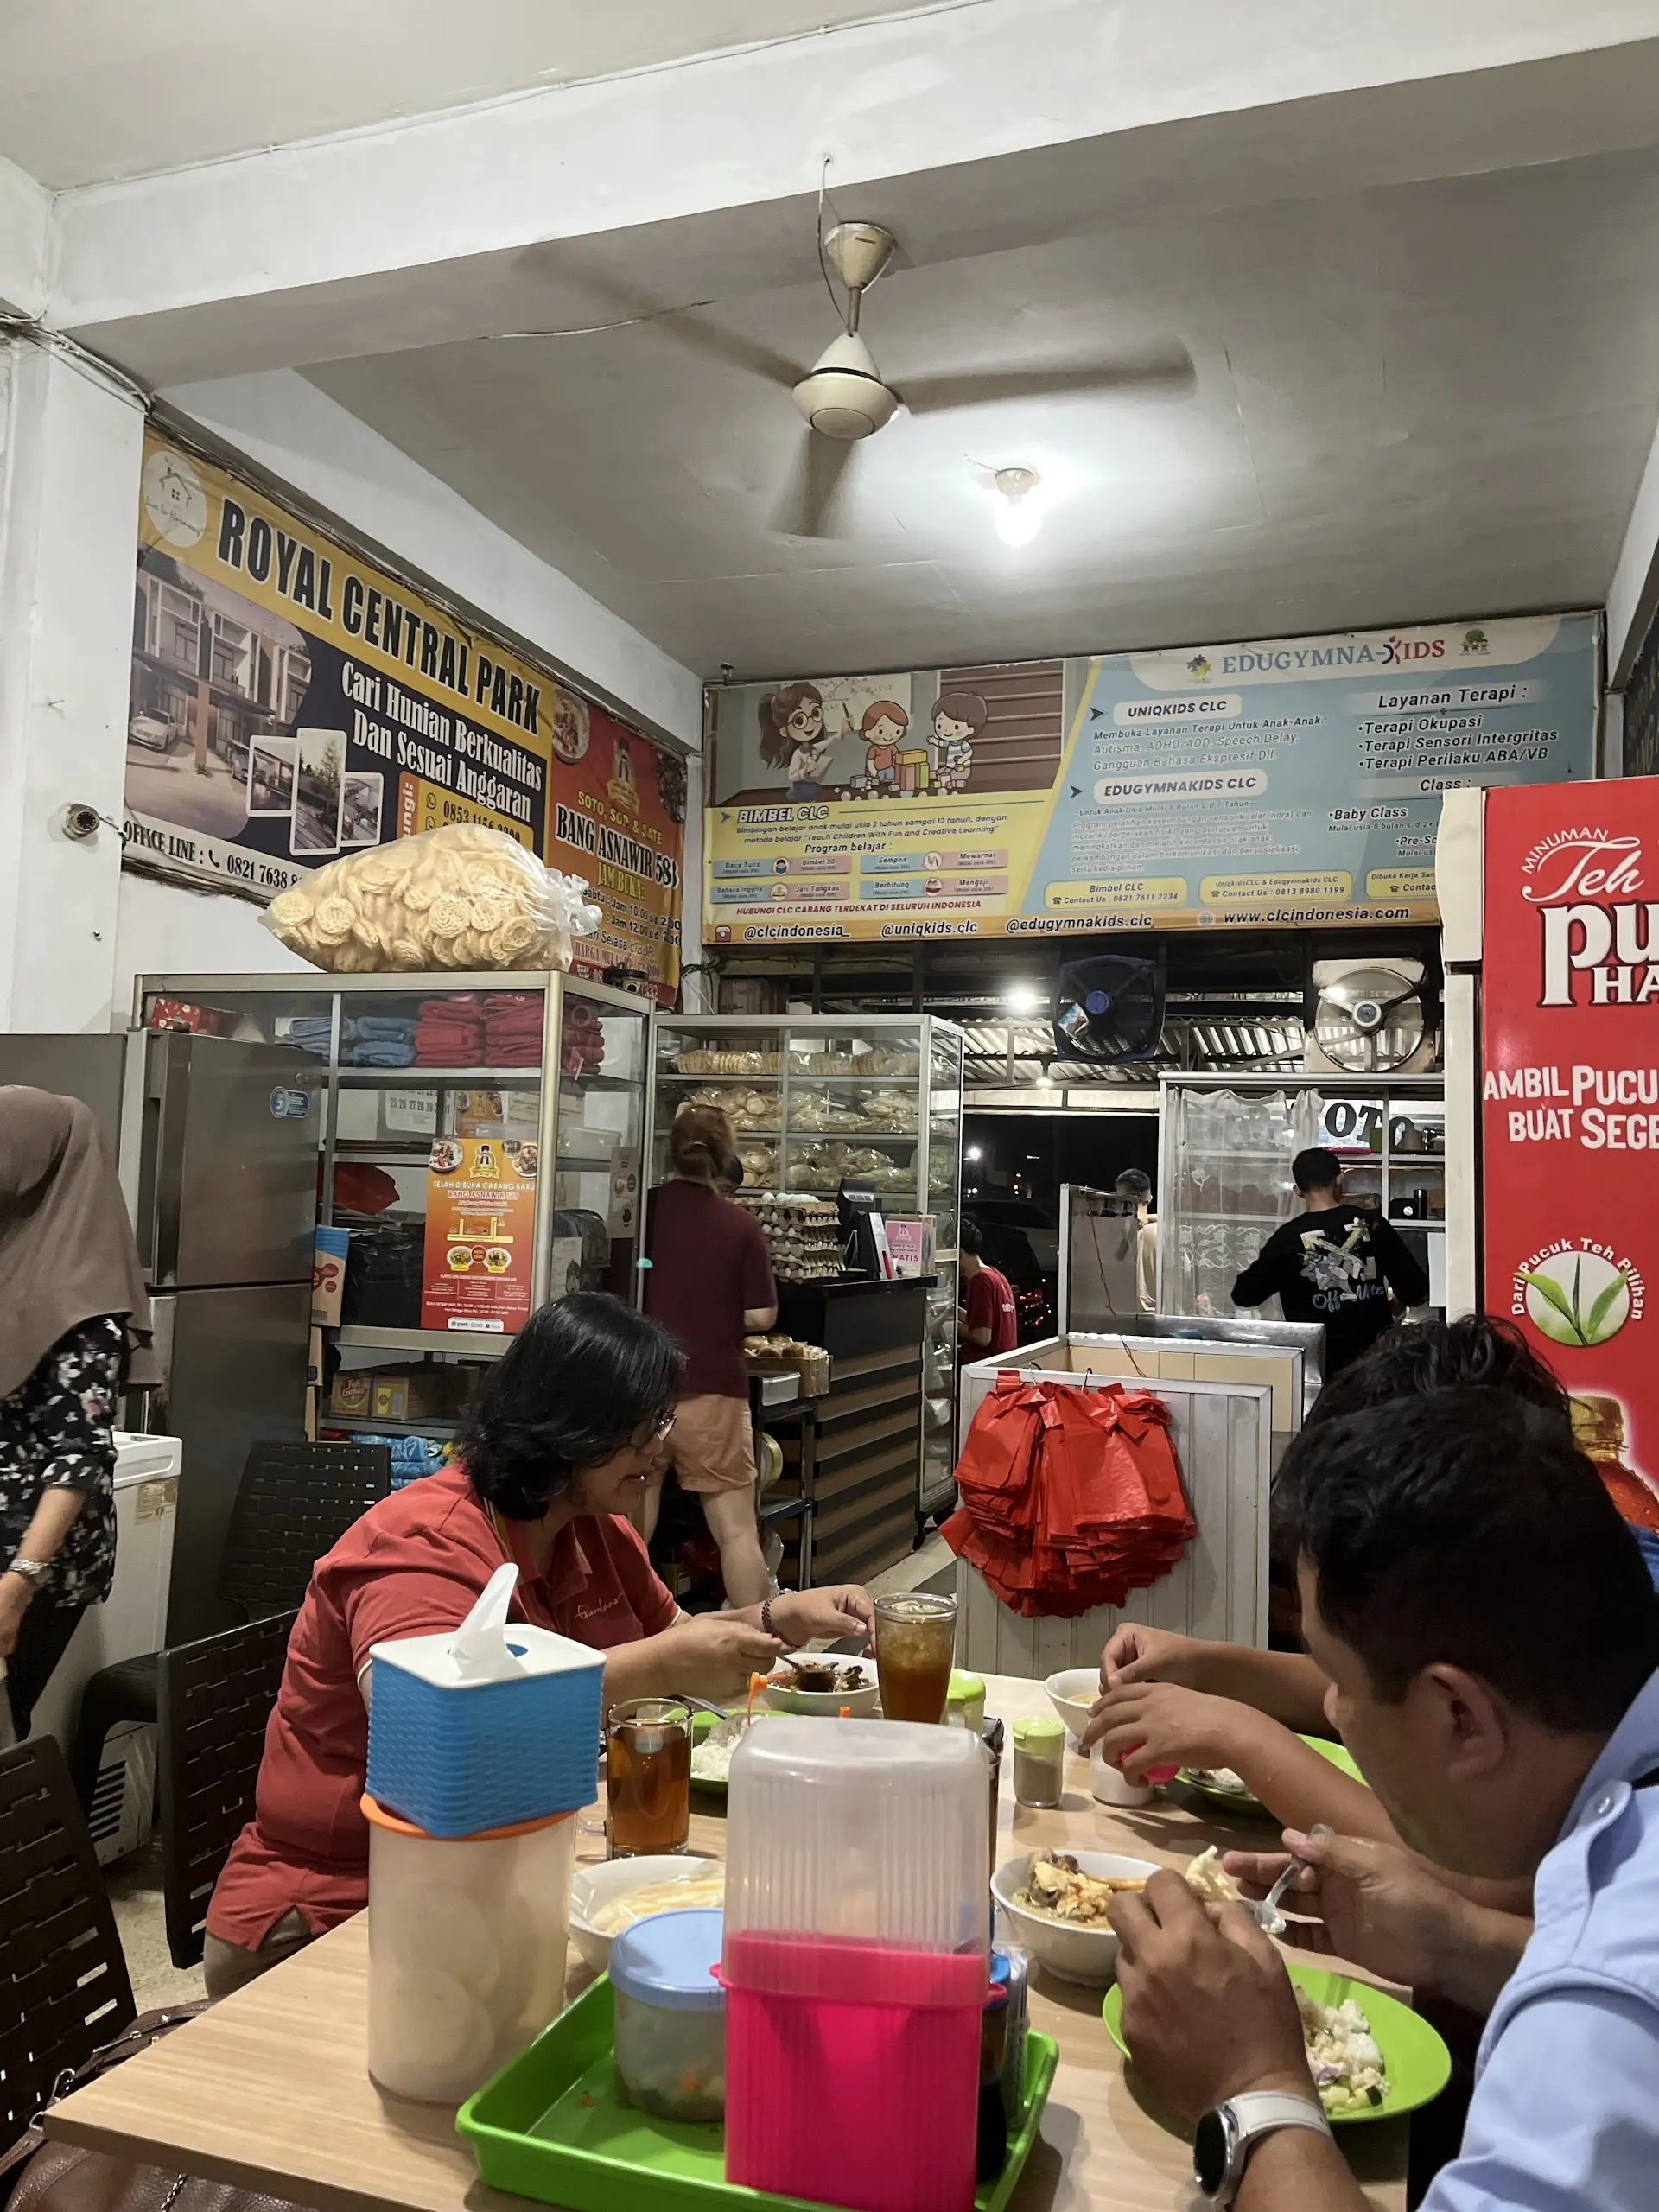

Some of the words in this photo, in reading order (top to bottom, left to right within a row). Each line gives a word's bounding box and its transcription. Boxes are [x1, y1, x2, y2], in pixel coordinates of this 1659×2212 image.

[218, 495, 334, 622] ROYAL
[341, 574, 470, 698] CENTRAL
[475, 652, 540, 736] PARK
[1378, 691, 1451, 709] Layanan
[1458, 685, 1517, 704] Terapi
[1128, 703, 1195, 717] UNIQKIDS
[1199, 700, 1227, 712] CLC
[342, 661, 380, 711] Cari
[386, 683, 450, 747] Hunian
[454, 719, 542, 791] Berkualitas
[1094, 728, 1142, 740] Membuka
[1146, 726, 1187, 737] Layanan
[1192, 723, 1224, 734] Terapi
[1228, 721, 1258, 730] Untuk
[1262, 716, 1321, 728] Anak-Anak
[1364, 720, 1414, 736] Terapi
[1418, 715, 1483, 733] Okupasi
[1217, 735, 1260, 747] Speech
[1364, 739, 1414, 754] Terapi
[1416, 734, 1472, 748] Sensori
[1477, 729, 1558, 747] Intergritas
[353, 709, 391, 760] Dan
[397, 731, 452, 786] Sesuai
[456, 761, 531, 822] Anggaran
[1094, 759, 1150, 772] Gangguan
[1154, 756, 1195, 767] Bahasa
[1200, 752, 1255, 765] Ekspresif
[1364, 756, 1414, 772] Terapi
[1417, 752, 1481, 766] Perilaku
[1485, 747, 1548, 762] ABA/VB
[1104, 779, 1224, 797] EDUGYMNAKIDS
[1228, 778, 1256, 789] CLC
[1421, 778, 1461, 791] Class
[443, 800, 469, 822] 0853
[577, 790, 607, 820] SOTO,
[642, 824, 663, 846] SATE
[737, 808, 793, 823] BIMBEL
[797, 805, 830, 820] CLC
[1334, 810, 1366, 822] Baby
[1371, 807, 1408, 818] Class
[737, 826, 778, 836] Bimbingan
[779, 824, 807, 834] belajar
[905, 817, 935, 828] sampai
[976, 815, 1007, 823] dengan
[744, 836, 772, 844] metode
[775, 835, 803, 844] belajar
[923, 827, 957, 836] Creative
[556, 804, 594, 855] BANG
[598, 824, 653, 880] ASNAWIR
[804, 843, 848, 855] Program
[851, 842, 886, 853] belajar
[1522, 827, 1609, 875] MINUMAN
[124, 821, 164, 851] OFFICE
[168, 836, 196, 862] LINE
[227, 855, 255, 881] 0821
[259, 865, 287, 889] 7638
[597, 861, 615, 889] JAM
[1522, 837, 1644, 901] Teh
[810, 885, 840, 893] Tangkas
[1090, 883, 1122, 893] Bimbel
[1125, 882, 1143, 891] CLC
[1269, 877, 1321, 887] Edugymnakids
[612, 897, 627, 912] Jam
[630, 905, 648, 919] 10.00
[834, 904, 878, 912] TERDEKAT
[931, 900, 981, 909] INDONESIA
[1224, 906, 1409, 923] www.clcindonesia.com
[612, 914, 626, 929] Jam
[629, 920, 648, 936] 12.00
[881, 921, 978, 938] @uniqkids.clc
[1007, 913, 1153, 933] @edugymnakids.clc
[601, 931, 628, 950] Selasa
[575, 941, 600, 963] HARGA
[1483, 1066, 1569, 1101] AMBIL
[1509, 1109, 1573, 1141] BUAT
[1510, 1274, 1526, 1315] Dari
[1518, 1238, 1573, 1275] Pucuk
[1580, 1237, 1615, 1260] Teh
[1617, 1257, 1646, 1320] Pilihan
